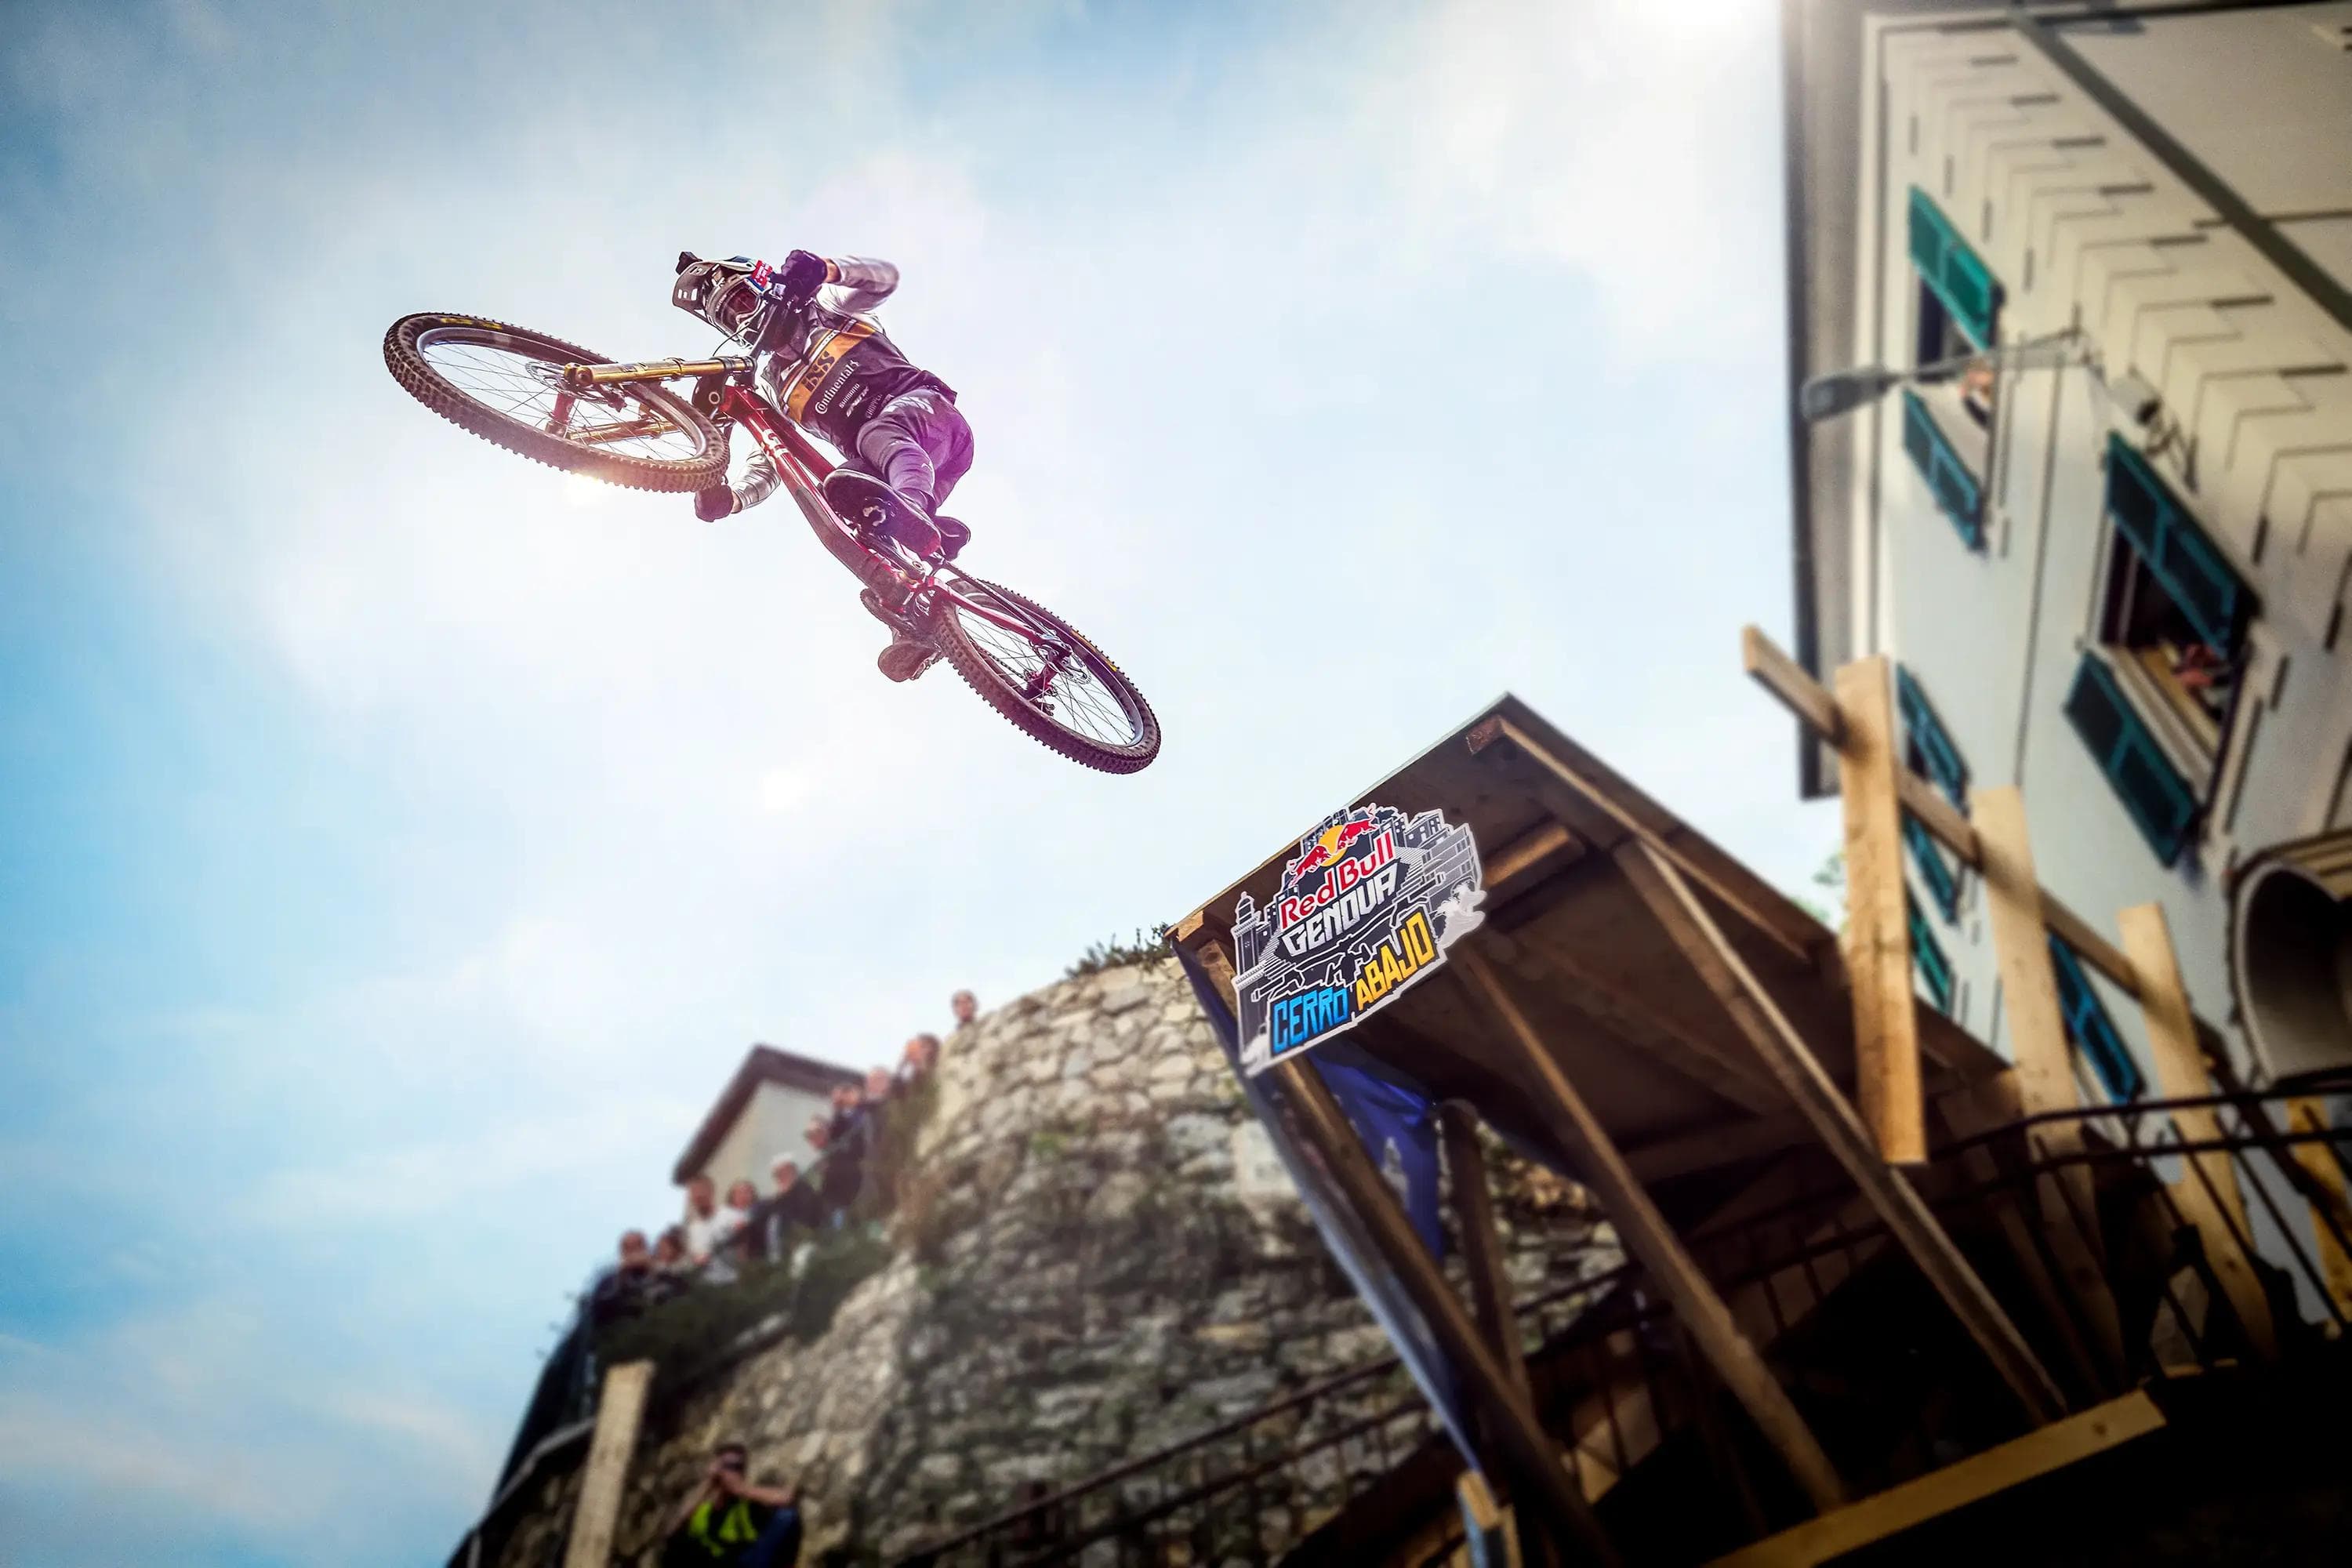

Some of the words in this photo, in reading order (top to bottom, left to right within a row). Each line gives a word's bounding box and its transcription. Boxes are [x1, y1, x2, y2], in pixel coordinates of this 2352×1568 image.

[815, 364, 855, 415] Continental
[839, 383, 860, 408] SHIMANO
[1279, 869, 1337, 930] Red
[1338, 832, 1394, 891] Bull
[1281, 863, 1398, 956] GENOVA
[1273, 987, 1349, 1053] CERRO
[1356, 911, 1436, 1011] ABAJO
